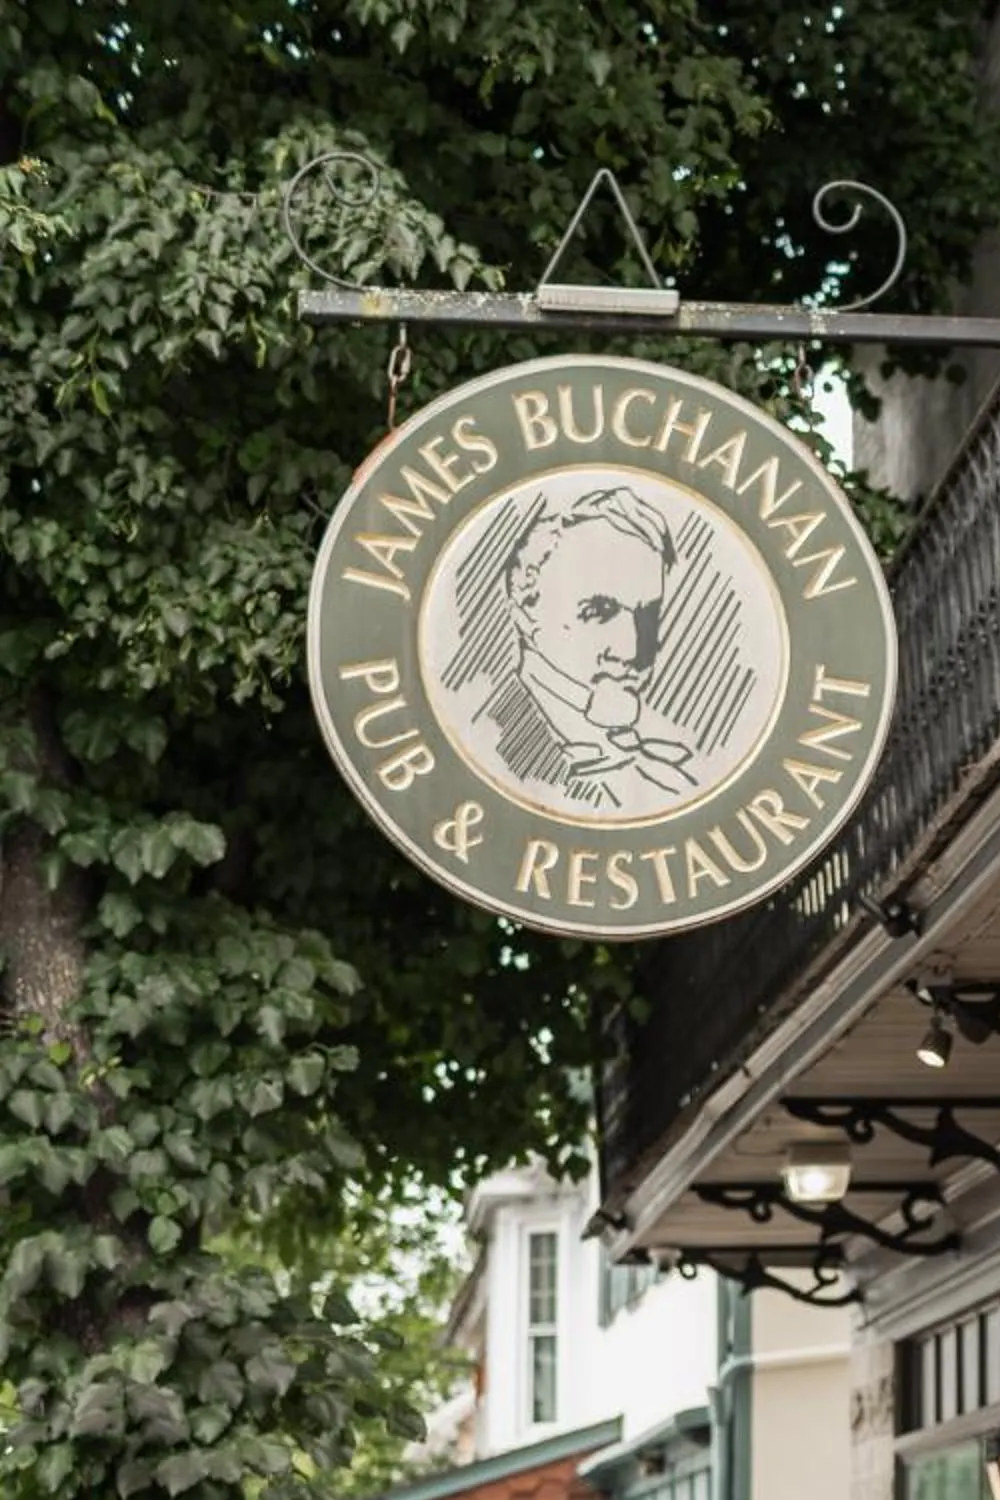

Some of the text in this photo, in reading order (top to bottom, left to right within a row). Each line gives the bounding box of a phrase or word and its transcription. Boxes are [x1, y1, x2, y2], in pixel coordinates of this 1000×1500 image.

[342, 383, 857, 600] JAMES BUCHANAN
[340, 658, 872, 910] PUB & RESTAURANT
